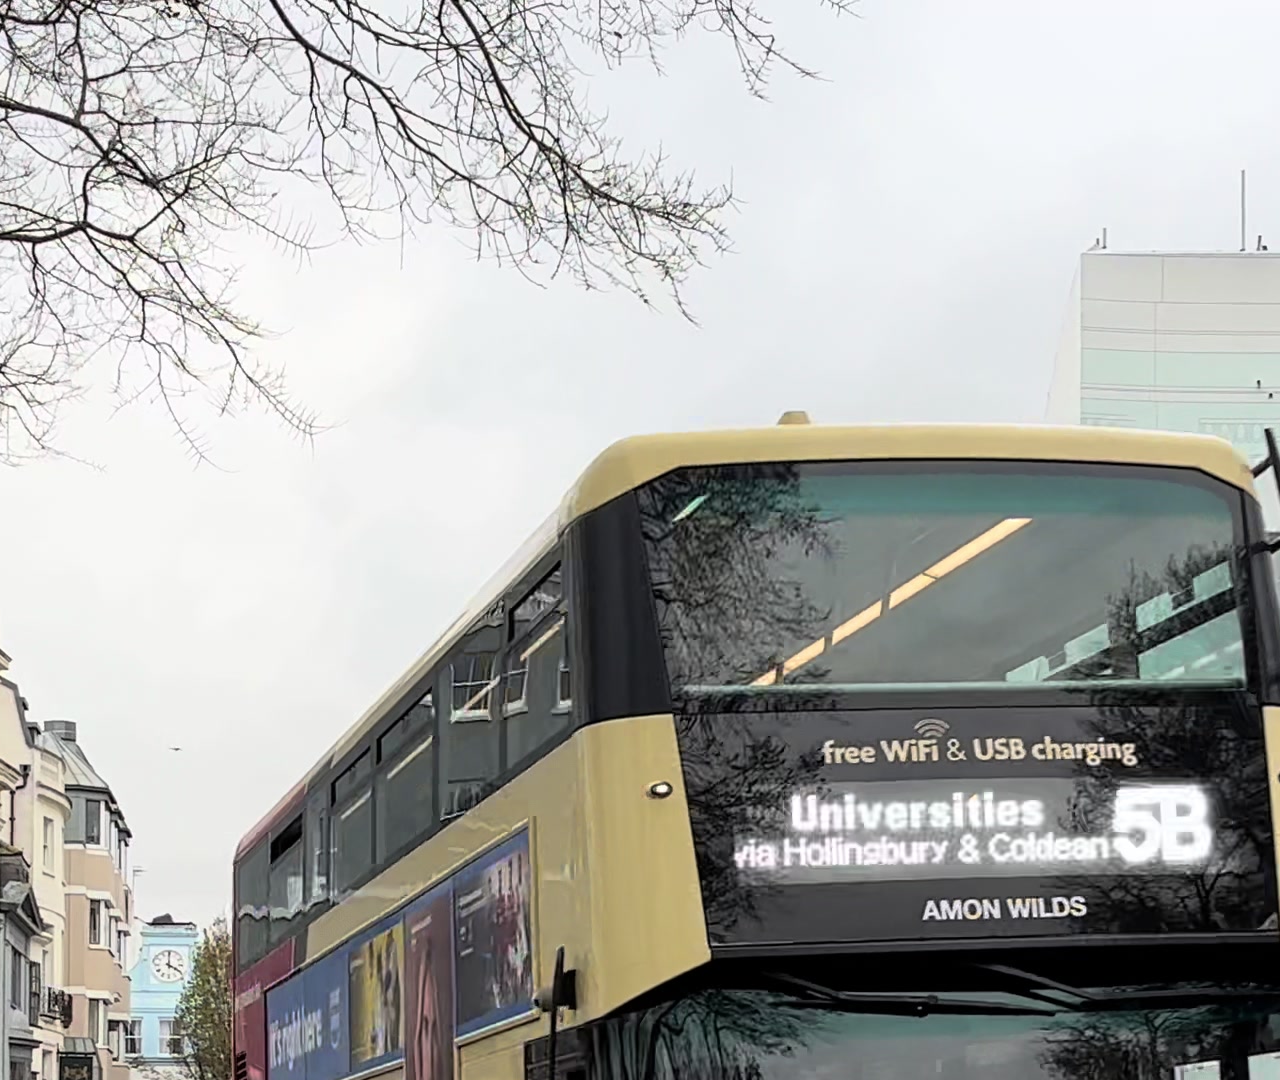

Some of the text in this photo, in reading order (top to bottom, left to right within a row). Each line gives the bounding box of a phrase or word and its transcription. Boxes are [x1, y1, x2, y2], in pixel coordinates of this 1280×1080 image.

[823, 735, 1138, 766] free WiFi & USB charging
[791, 792, 1044, 830] Universities
[1113, 785, 1211, 863] 5B
[734, 839, 776, 867] via
[957, 833, 981, 864] &
[988, 831, 1109, 862] Coldean
[922, 896, 1087, 920] AMON WILDS
